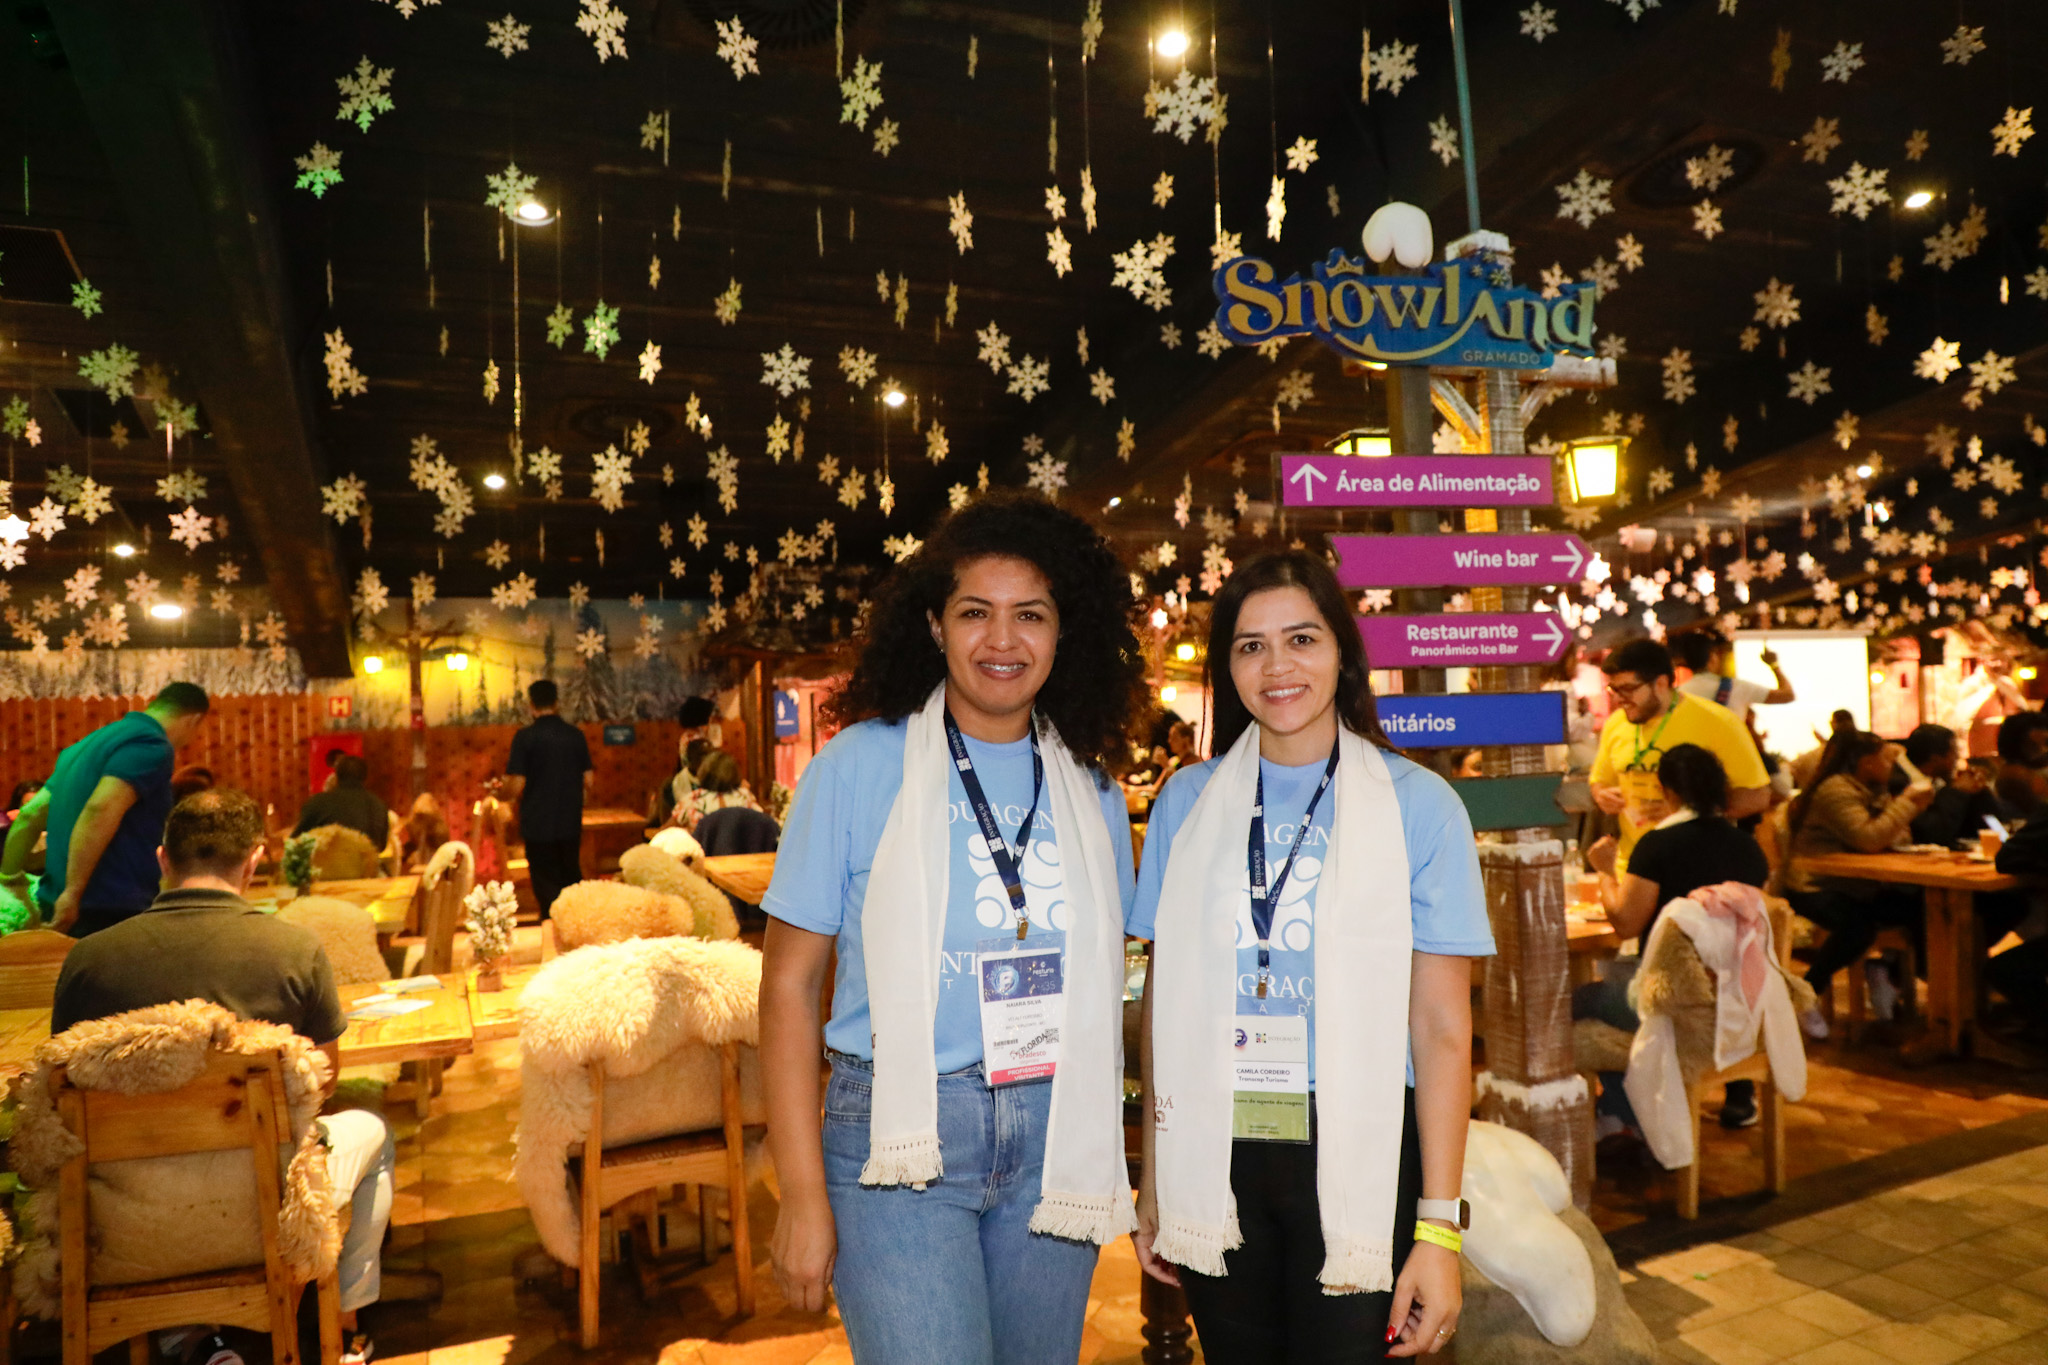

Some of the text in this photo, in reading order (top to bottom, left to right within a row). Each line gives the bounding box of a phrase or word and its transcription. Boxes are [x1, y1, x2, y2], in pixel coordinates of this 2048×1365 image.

[1463, 350, 1540, 364] GRAMADO
[1336, 470, 1541, 496] Área de Alimentação
[1454, 549, 1539, 568] Wine bar
[1407, 624, 1519, 641] Restaurante
[1411, 643, 1519, 657] Panorâmico Ice Bar
[1379, 713, 1456, 733] nitários
[1007, 1065, 1051, 1076] PROFISSIONAL
[1260, 1068, 1291, 1076] CORDEIRO
